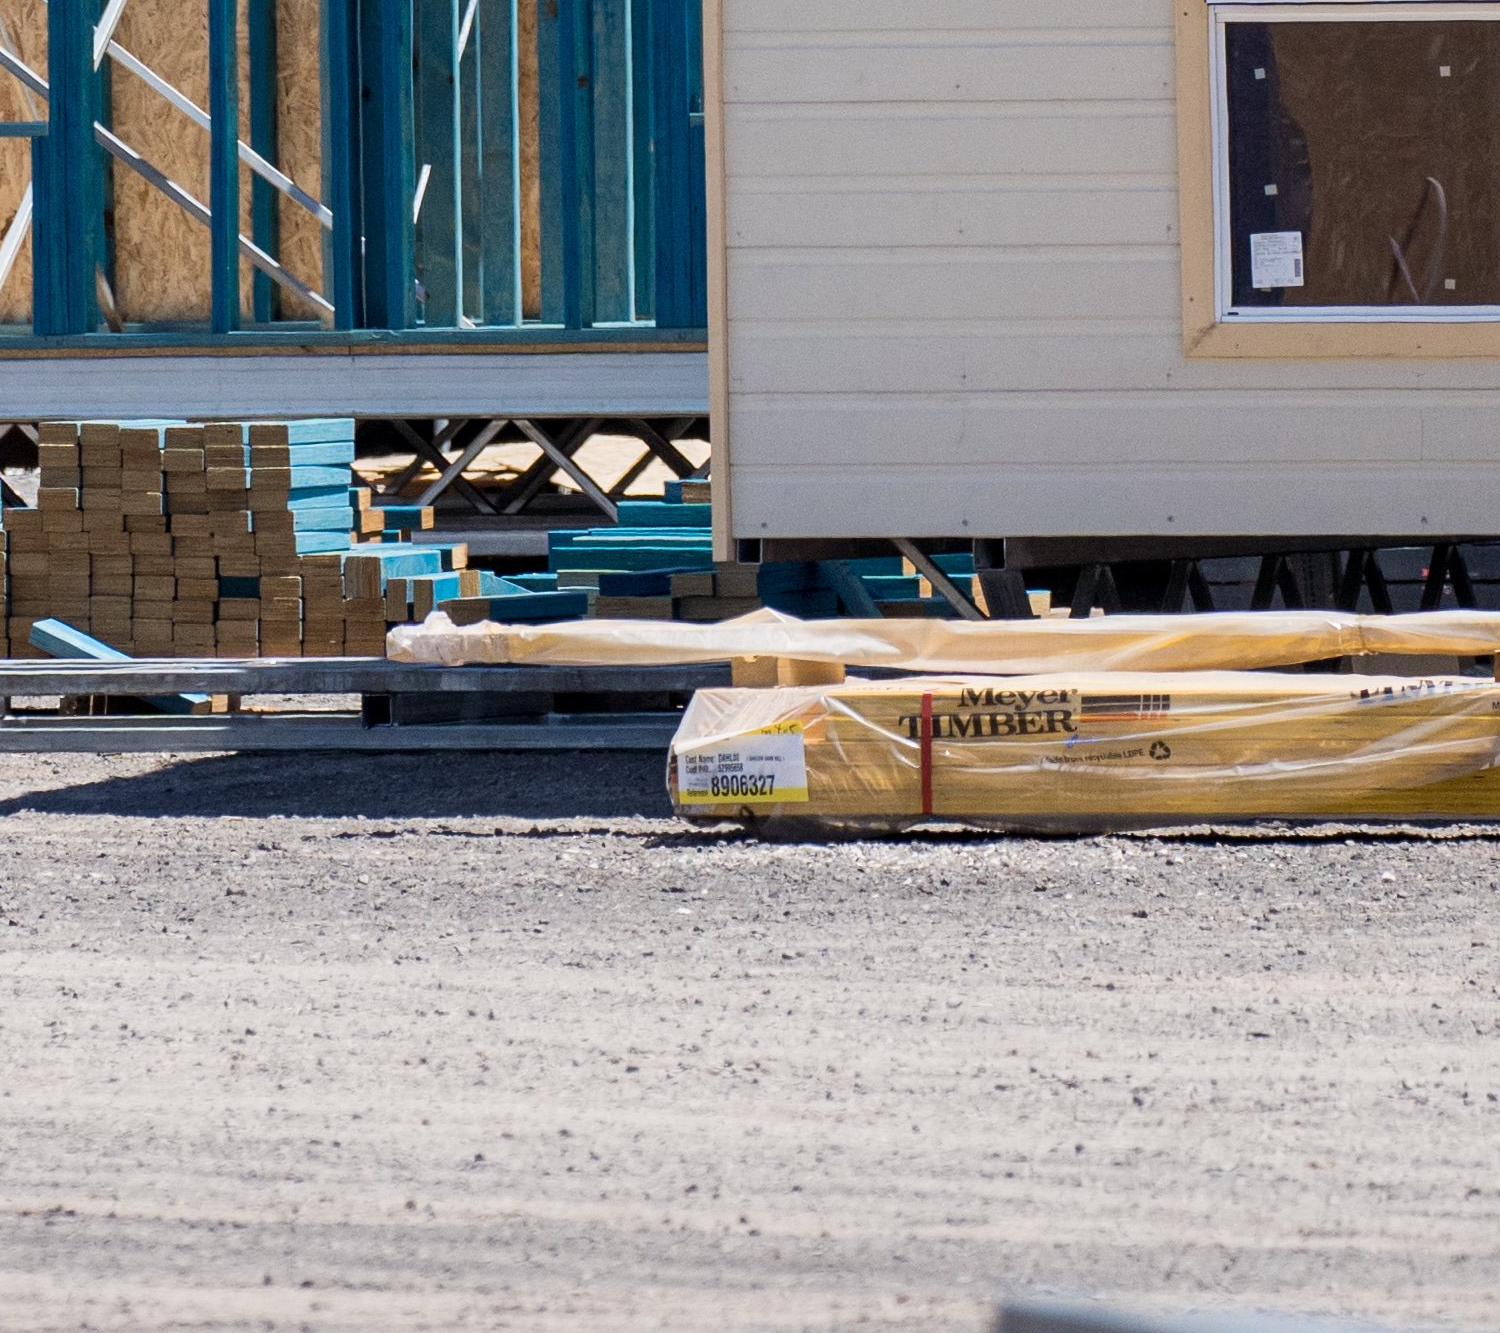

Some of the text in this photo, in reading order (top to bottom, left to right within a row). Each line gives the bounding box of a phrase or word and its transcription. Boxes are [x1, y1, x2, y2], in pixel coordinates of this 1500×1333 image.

[957, 688, 1078, 711] Meyer
[899, 709, 1079, 740] TIMBER
[711, 774, 775, 797] 8906327
